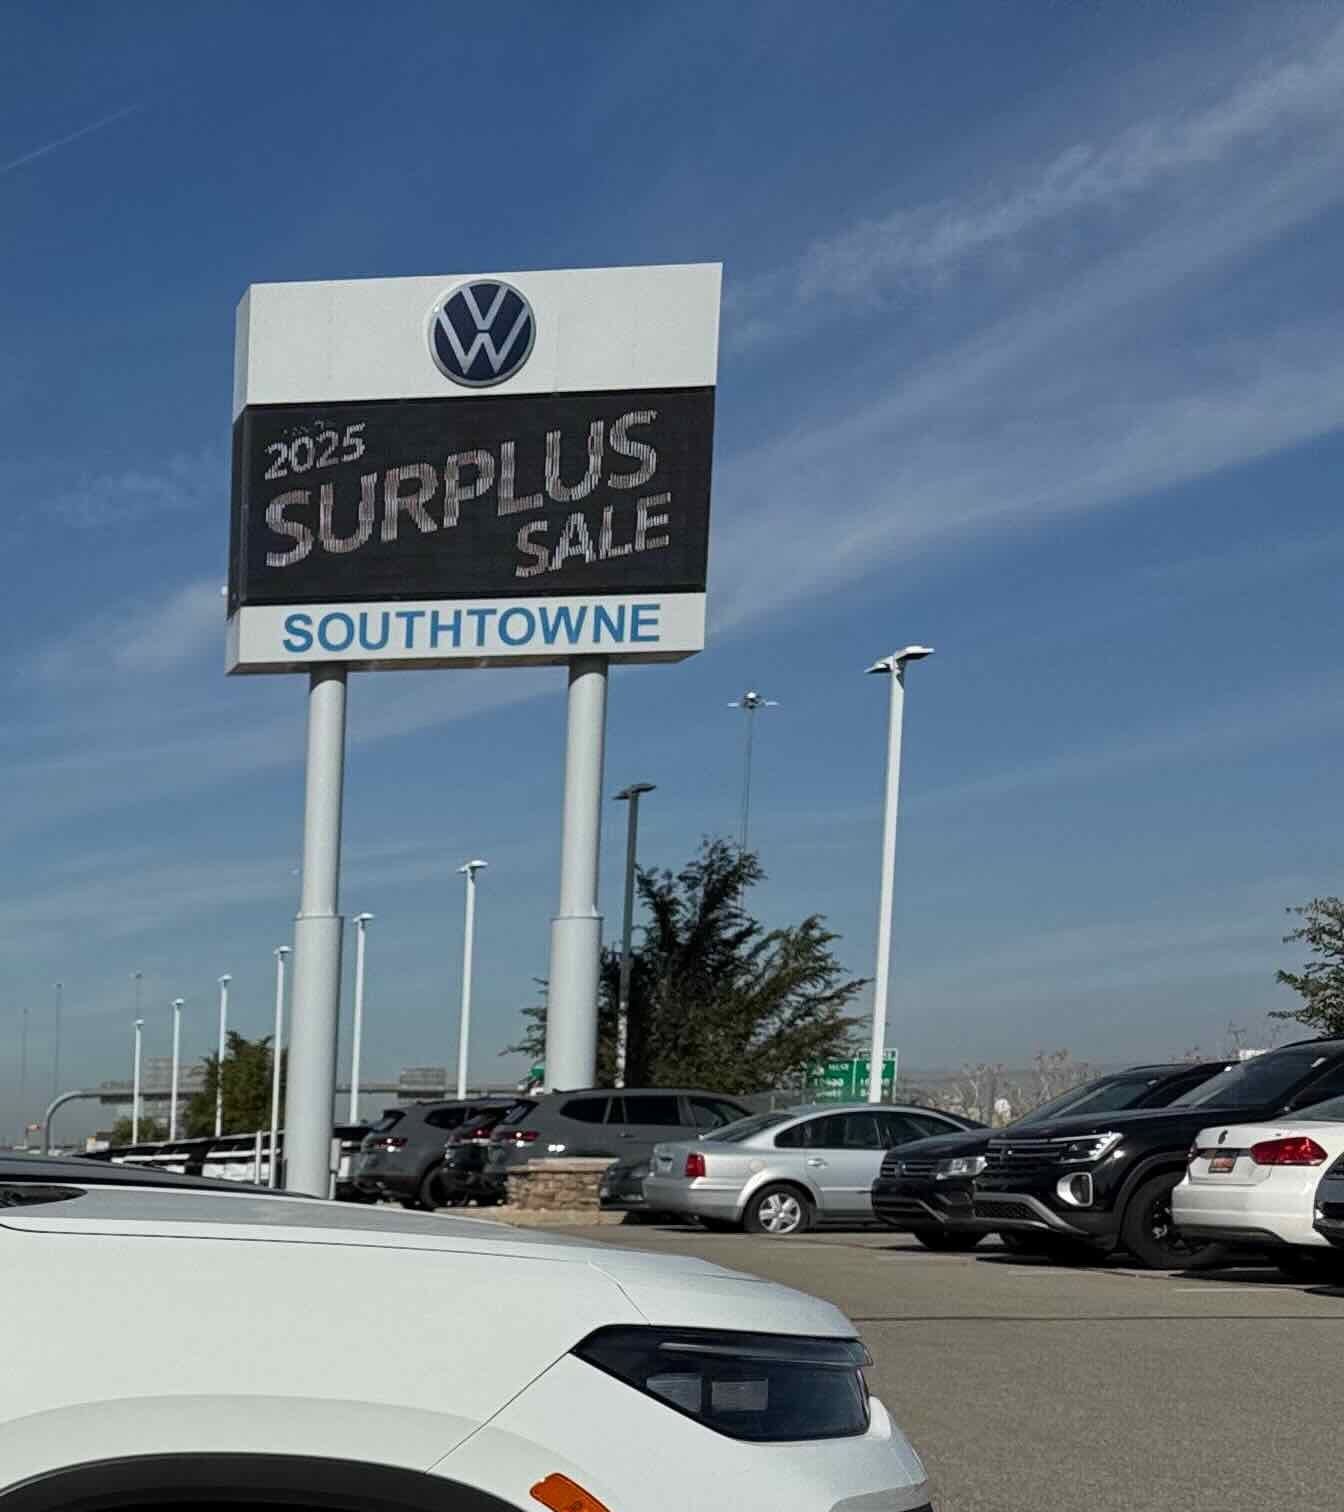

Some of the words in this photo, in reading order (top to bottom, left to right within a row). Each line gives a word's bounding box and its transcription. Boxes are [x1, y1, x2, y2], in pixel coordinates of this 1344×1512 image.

[264, 420, 367, 480] 2025
[264, 409, 659, 568] SURPLUS
[514, 492, 672, 578] SALE
[282, 603, 661, 654] SOUTHTOWNE
